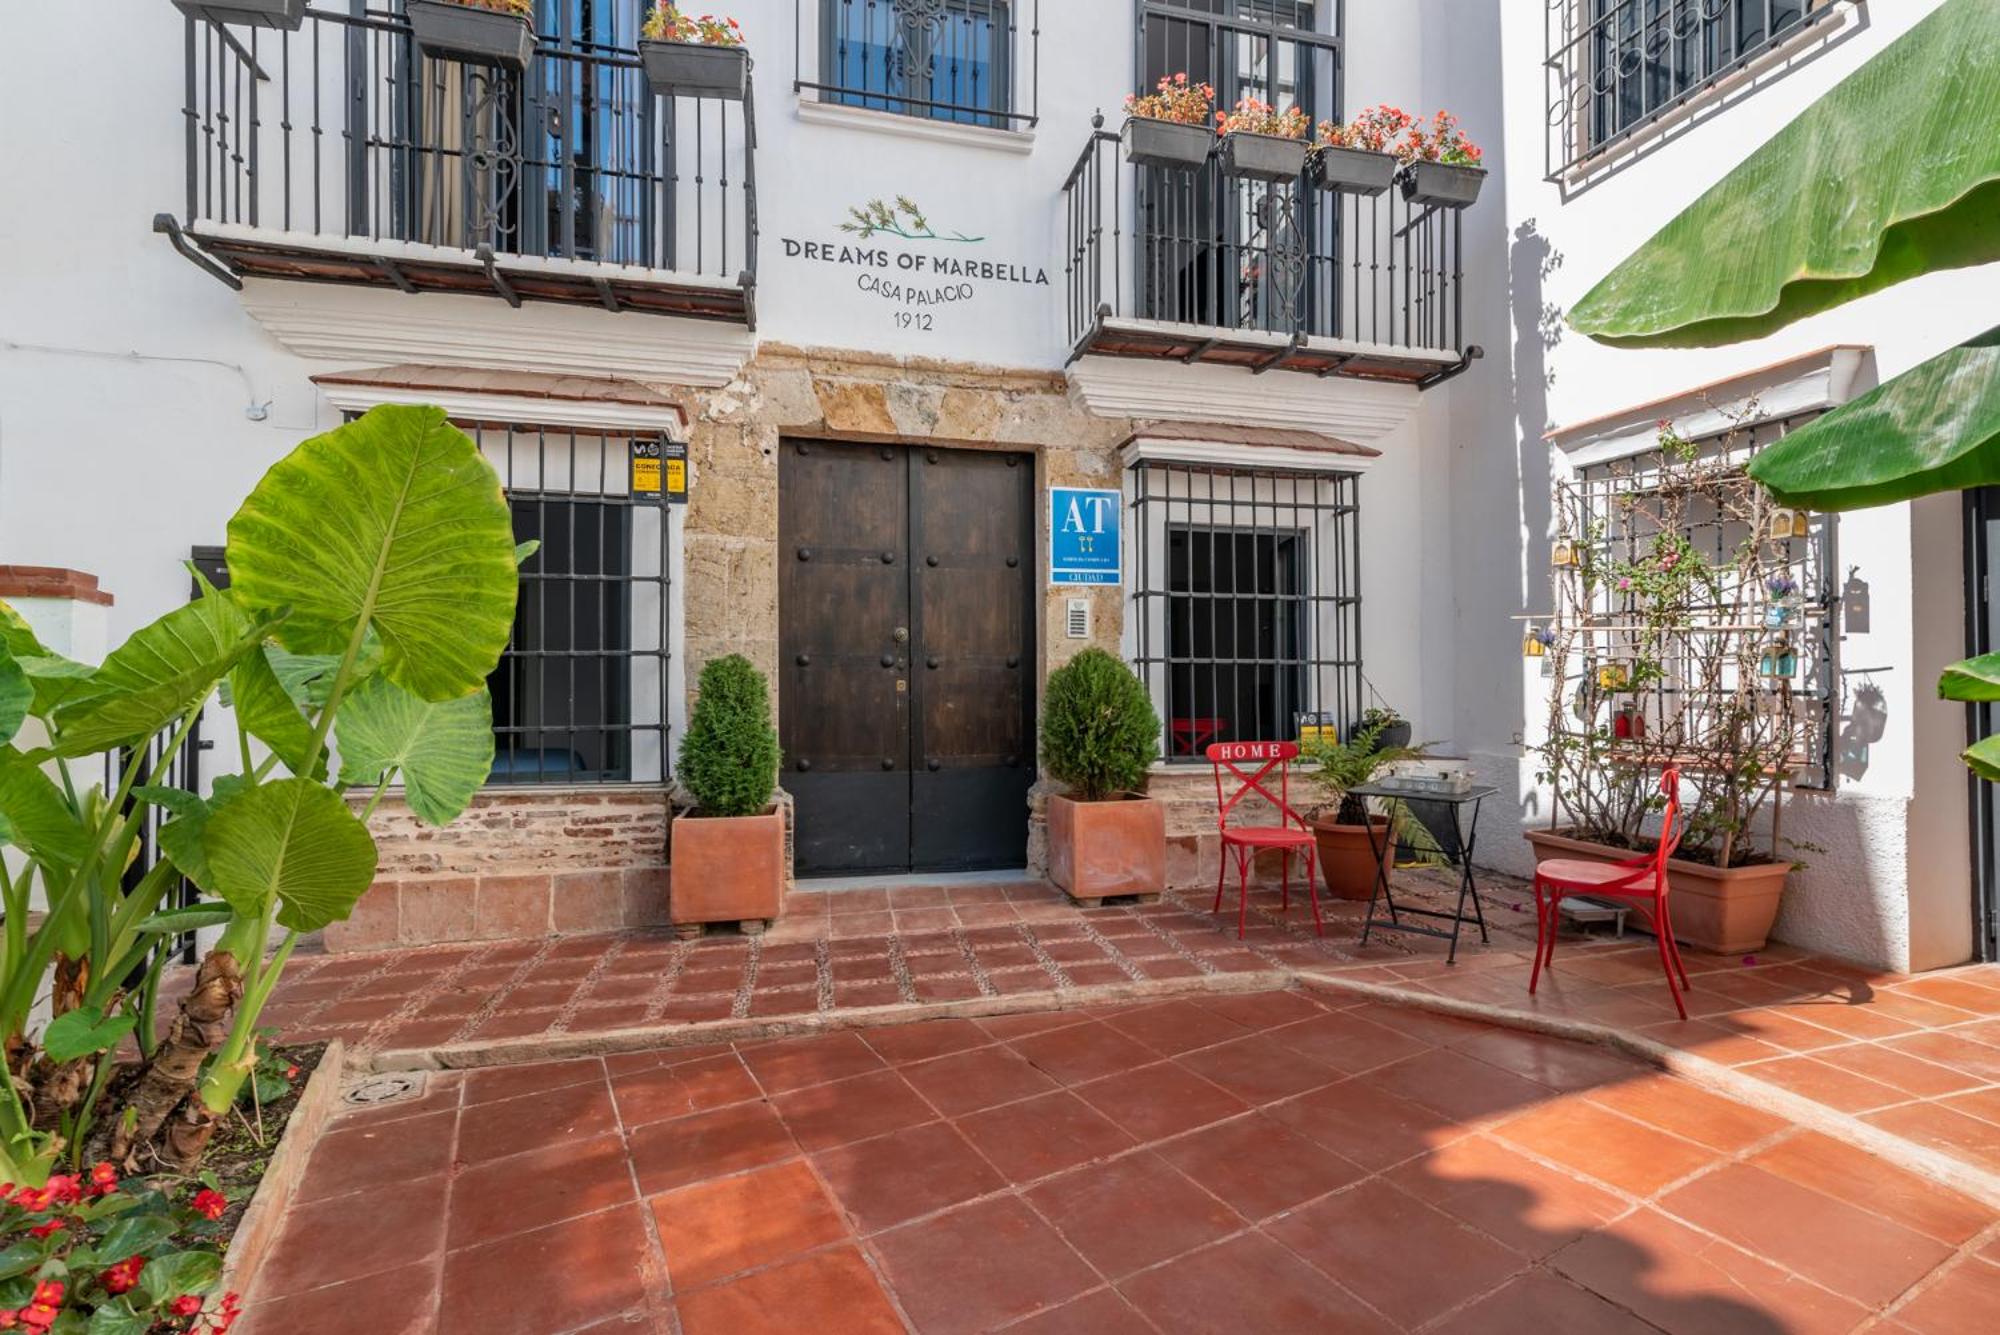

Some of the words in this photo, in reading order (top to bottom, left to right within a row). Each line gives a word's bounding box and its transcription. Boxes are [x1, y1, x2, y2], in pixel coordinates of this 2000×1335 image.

[781, 238, 889, 268] DREAMS
[897, 253, 926, 271] OF
[933, 257, 1050, 285] MARBELLA
[857, 274, 901, 301] CASA
[906, 283, 973, 305] PALACIO
[894, 312, 933, 331] 1912
[1061, 495, 1112, 534] AT
[1068, 573, 1104, 582] CIUDAD
[1221, 743, 1281, 759] HOME
